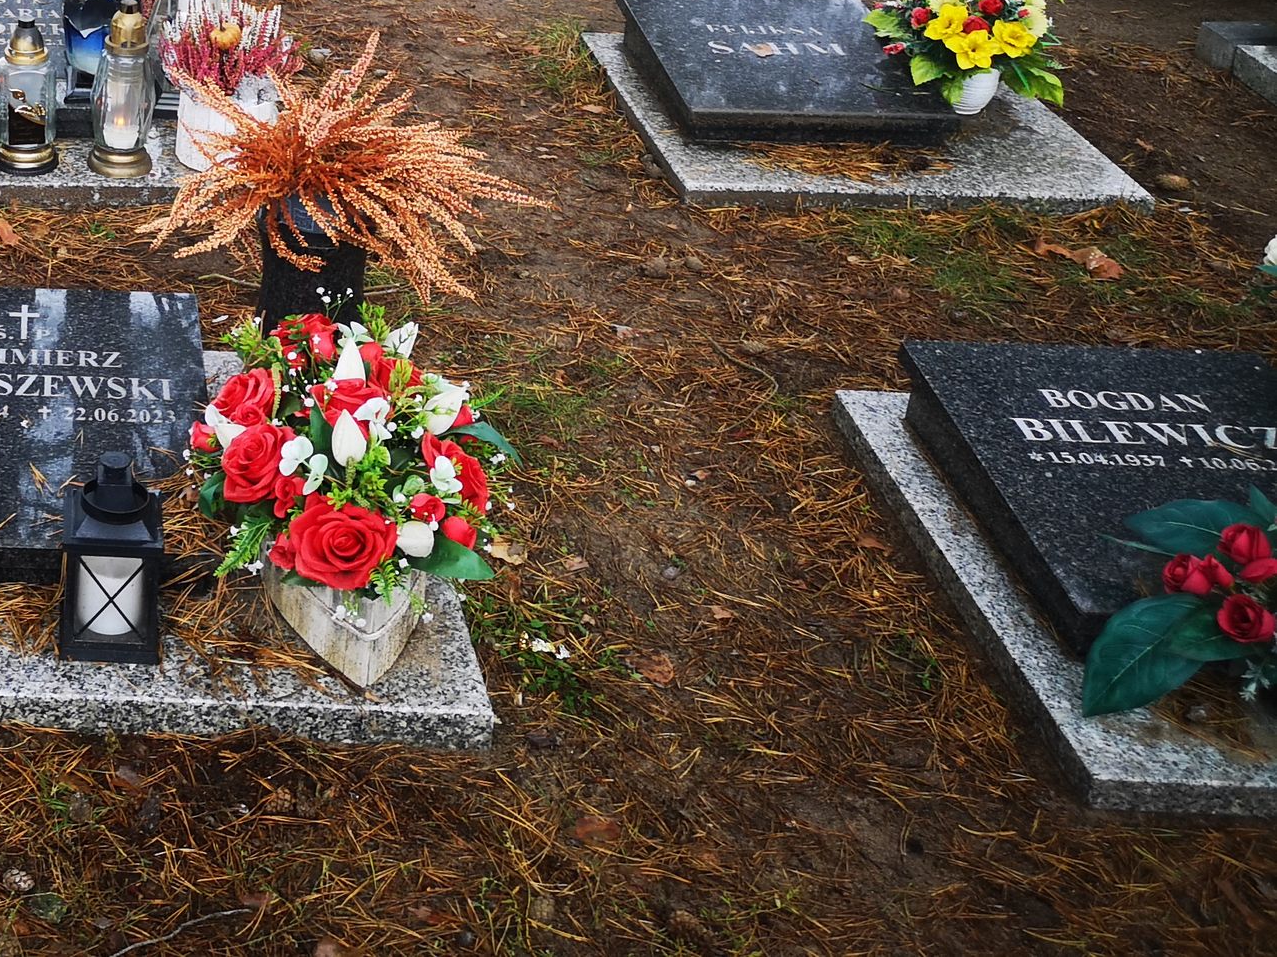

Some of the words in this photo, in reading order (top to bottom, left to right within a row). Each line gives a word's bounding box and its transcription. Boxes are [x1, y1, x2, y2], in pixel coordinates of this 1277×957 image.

[1036, 388, 1212, 414] BOGDAN
[1047, 451, 1167, 468] 15.04.1937
[1202, 458, 1277, 472] 10.06.2
